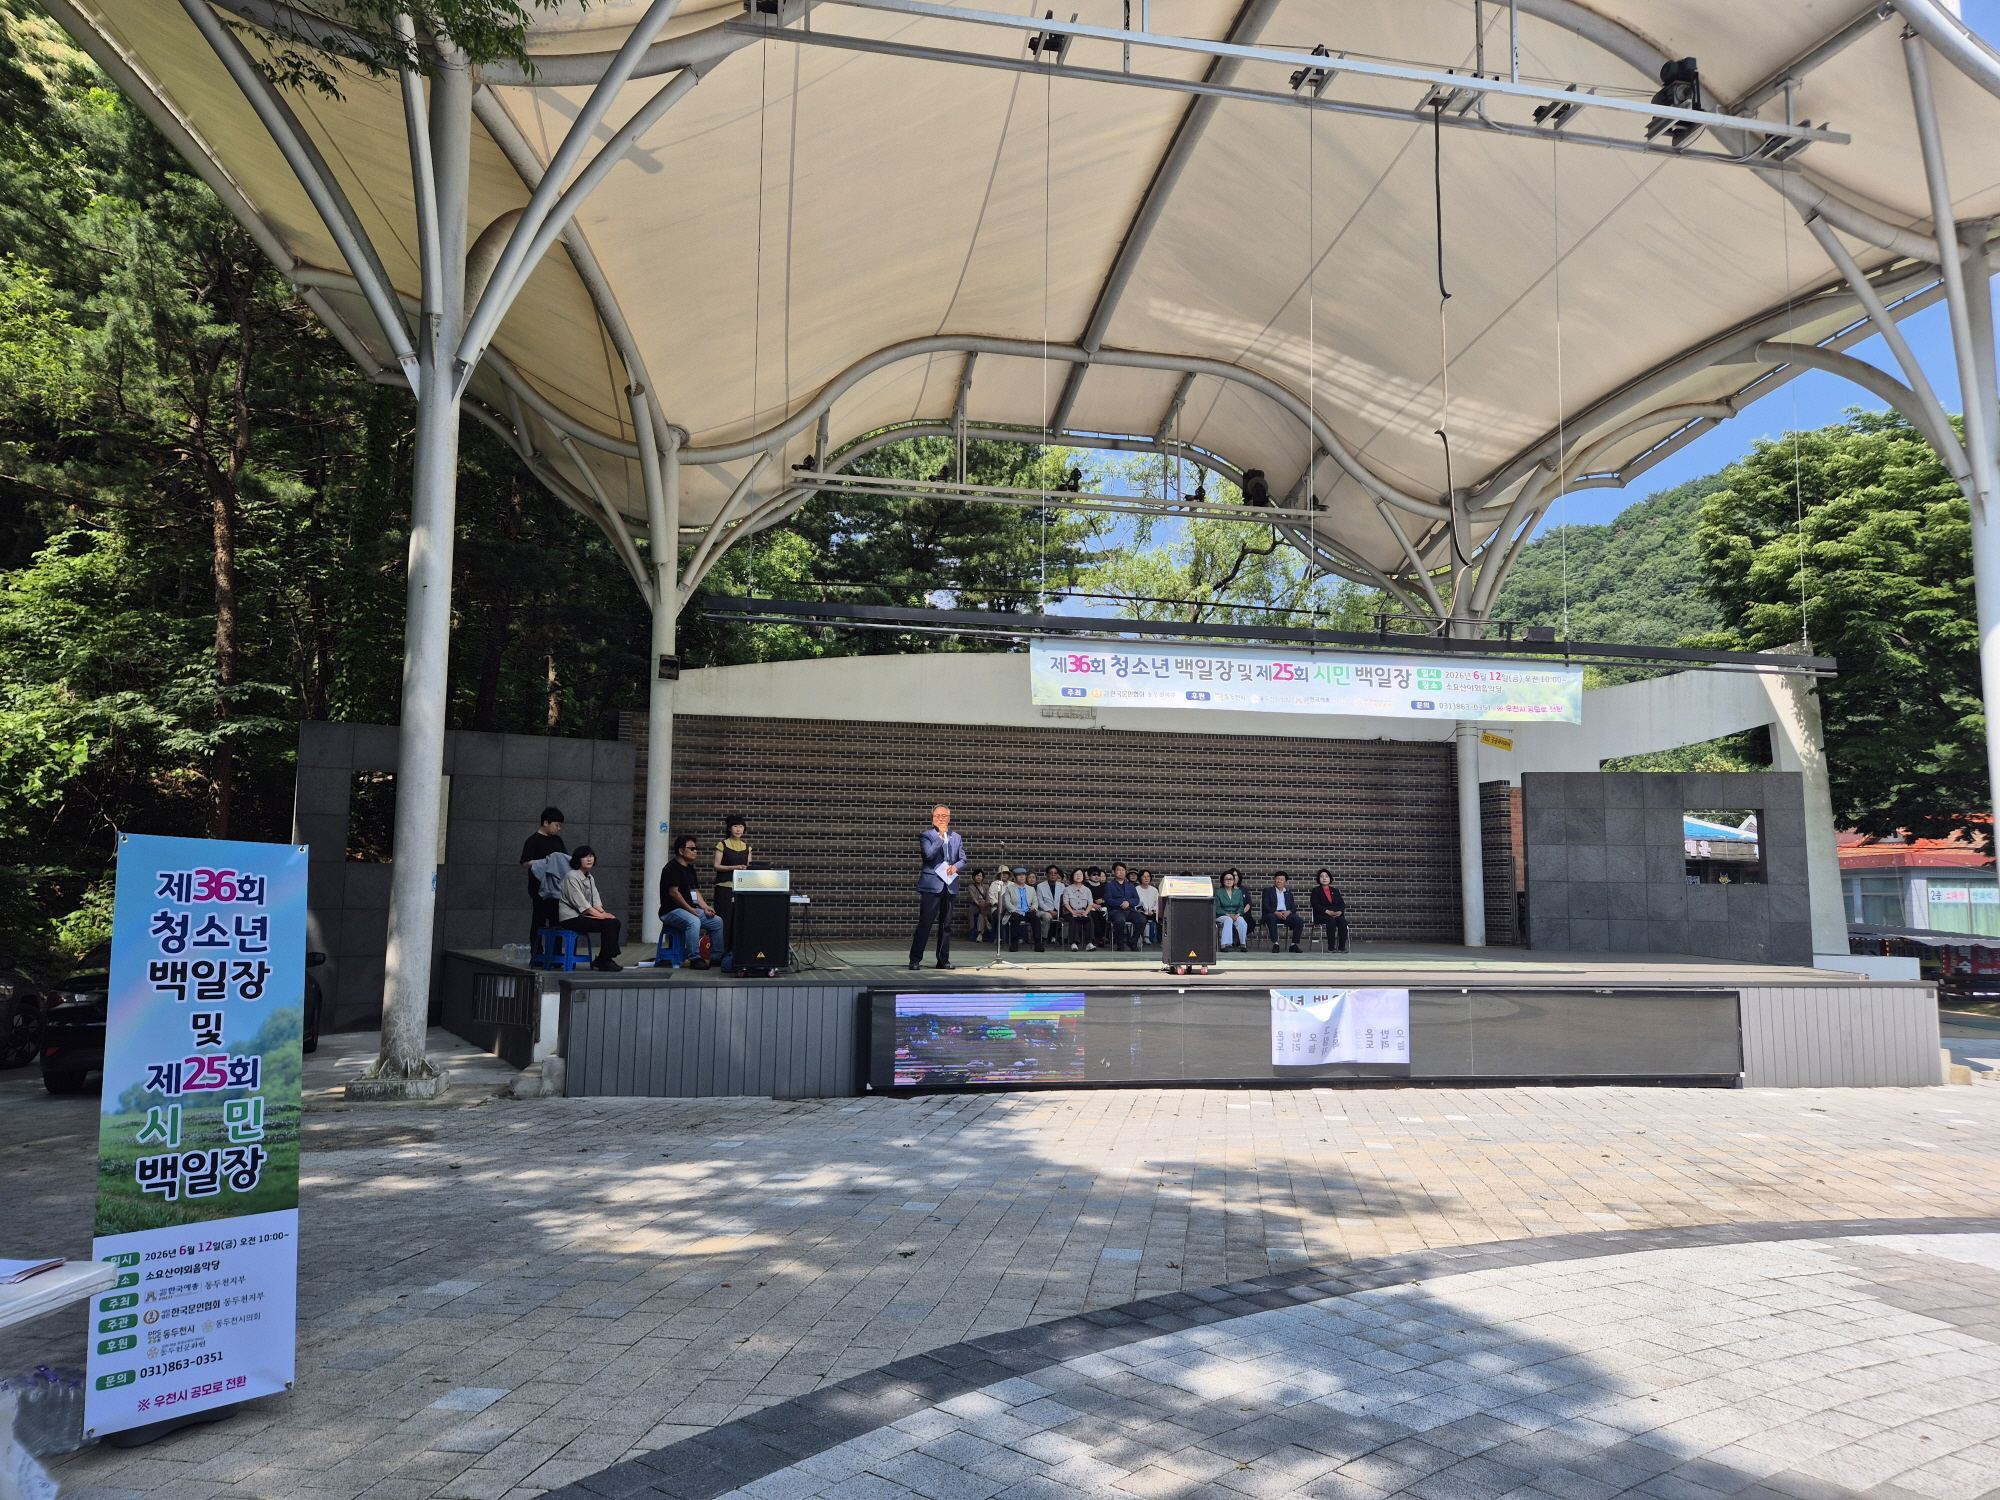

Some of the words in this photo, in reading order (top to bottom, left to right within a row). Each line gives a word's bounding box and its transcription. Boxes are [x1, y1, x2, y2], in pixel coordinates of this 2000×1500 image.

[1050, 654, 1106, 675] 제36회
[1110, 655, 1170, 679] 청소년
[1174, 658, 1235, 682] 백일장
[1237, 663, 1253, 682] 및
[1256, 662, 1309, 683] 제25회
[1313, 665, 1351, 687] 시민
[1355, 666, 1412, 689] 백일장
[1421, 669, 1437, 678] 일시
[1445, 671, 1472, 681] 2026년
[1473, 670, 1487, 682] 6월
[1489, 671, 1523, 683] 12일(금)
[1066, 688, 1083, 697] 주최
[1191, 692, 1206, 700] 후원
[1422, 681, 1438, 690] 장소
[1416, 701, 1430, 710] 문의
[157, 869, 265, 905] 제36회
[151, 910, 269, 954] 청소년
[150, 960, 271, 1001] 백일장
[192, 1012, 222, 1047] 및
[146, 1056, 261, 1094] 제25회
[138, 1147, 265, 1199] 백일장
[144, 1248, 177, 1262] 2026년
[179, 1244, 195, 1256] 6월
[198, 1239, 237, 1254] 12일(금)
[239, 1236, 256, 1247] 오전
[258, 1231, 290, 1243] 10:00~
[145, 1260, 221, 1281] 소요산야외음악당
[108, 1295, 130, 1309] 주최
[171, 1300, 221, 1318] 한국문인협회
[107, 1316, 129, 1330] 주관
[162, 1324, 195, 1340] 동두천시
[216, 1312, 261, 1329] 동두천시의회
[106, 1338, 129, 1352] 후원
[140, 1351, 223, 1380] 031)863-0351
[105, 1372, 127, 1387] 문의
[153, 1389, 188, 1407] 우천시
[190, 1381, 223, 1400] 공모로
[225, 1375, 247, 1391] 전환
